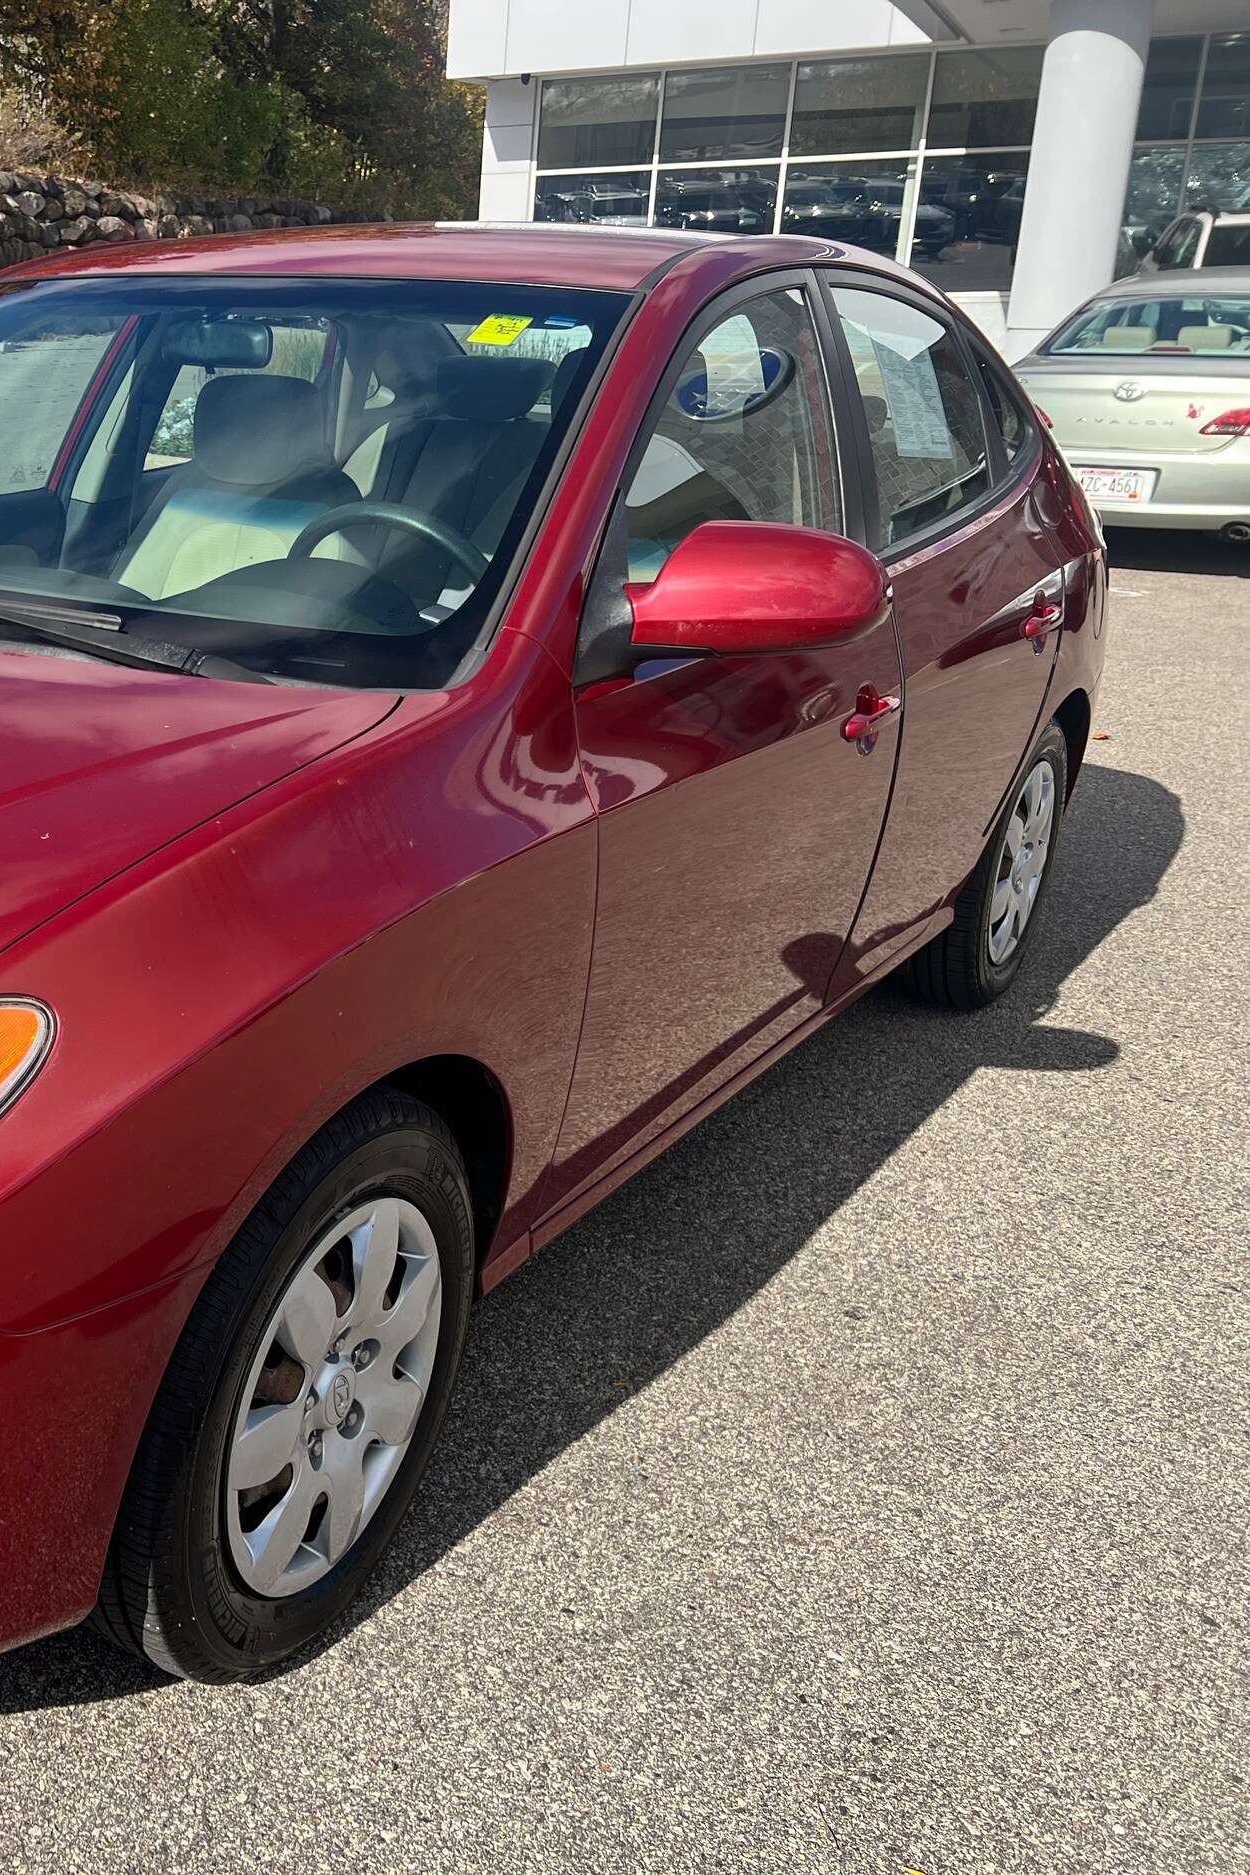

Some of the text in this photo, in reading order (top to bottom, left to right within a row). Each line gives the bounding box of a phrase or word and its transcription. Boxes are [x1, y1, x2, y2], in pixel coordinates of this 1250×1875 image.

[1077, 417, 1175, 426] AVALON
[441, 1174, 471, 1269] MICHELIN
[203, 1552, 247, 1644] MICHELIN
